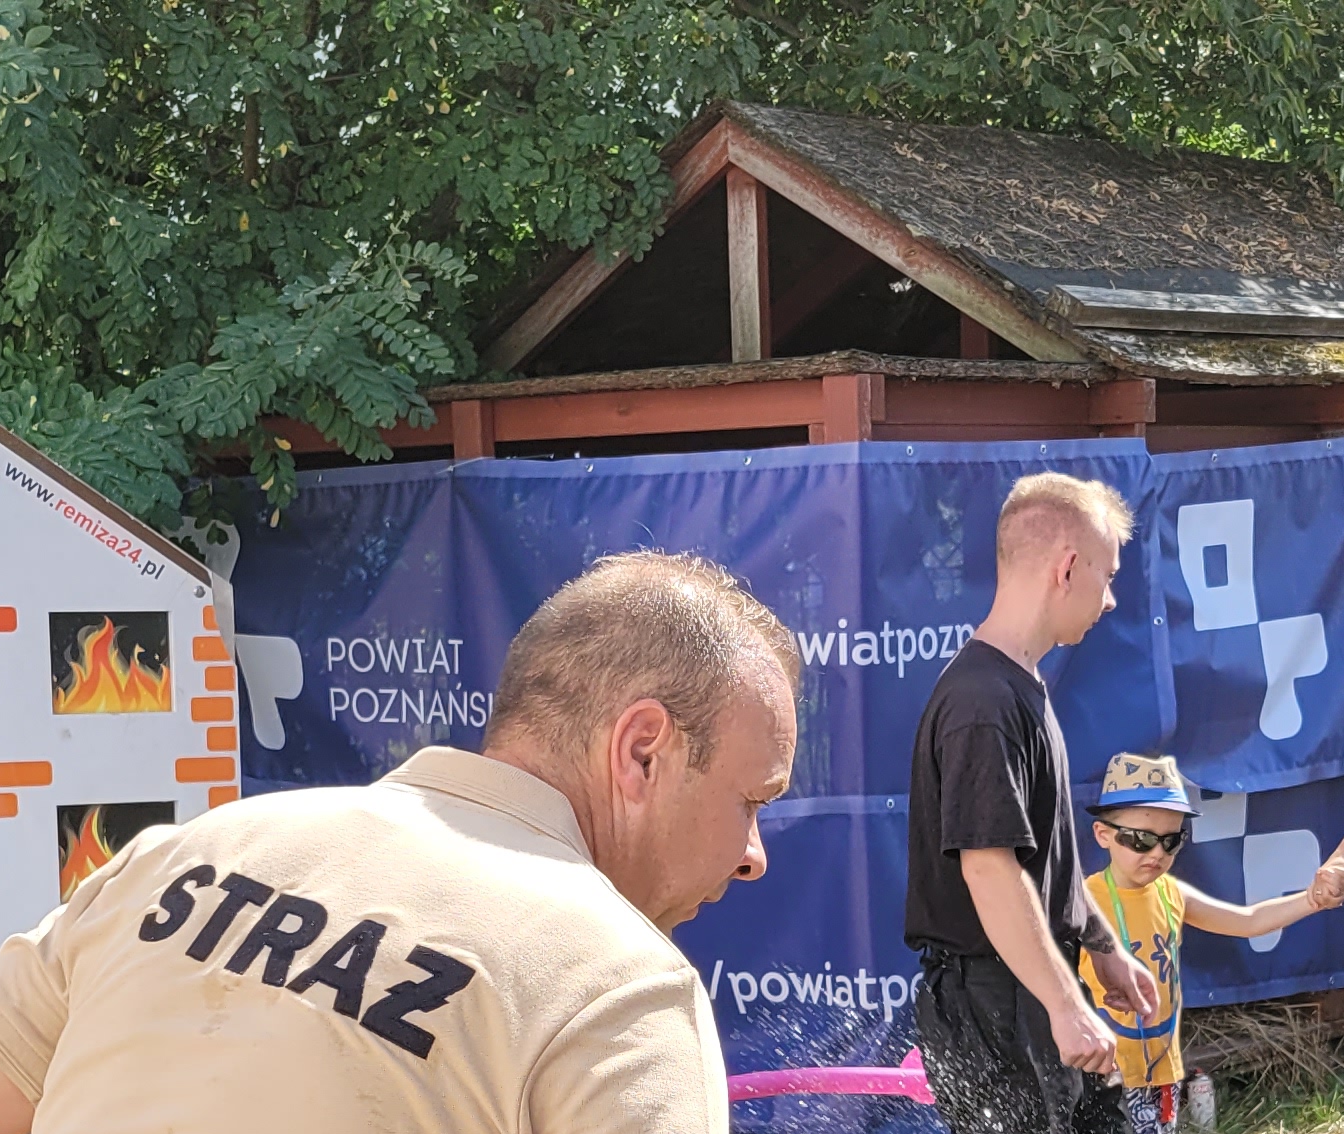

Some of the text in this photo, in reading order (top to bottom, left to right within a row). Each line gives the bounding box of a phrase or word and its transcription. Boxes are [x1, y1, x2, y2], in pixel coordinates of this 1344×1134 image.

[5, 463, 165, 579] www.remiza24.pl
[327, 637, 463, 674] POWIAT
[797, 618, 974, 678] wiatpozn
[329, 682, 494, 727] POZNAŃS
